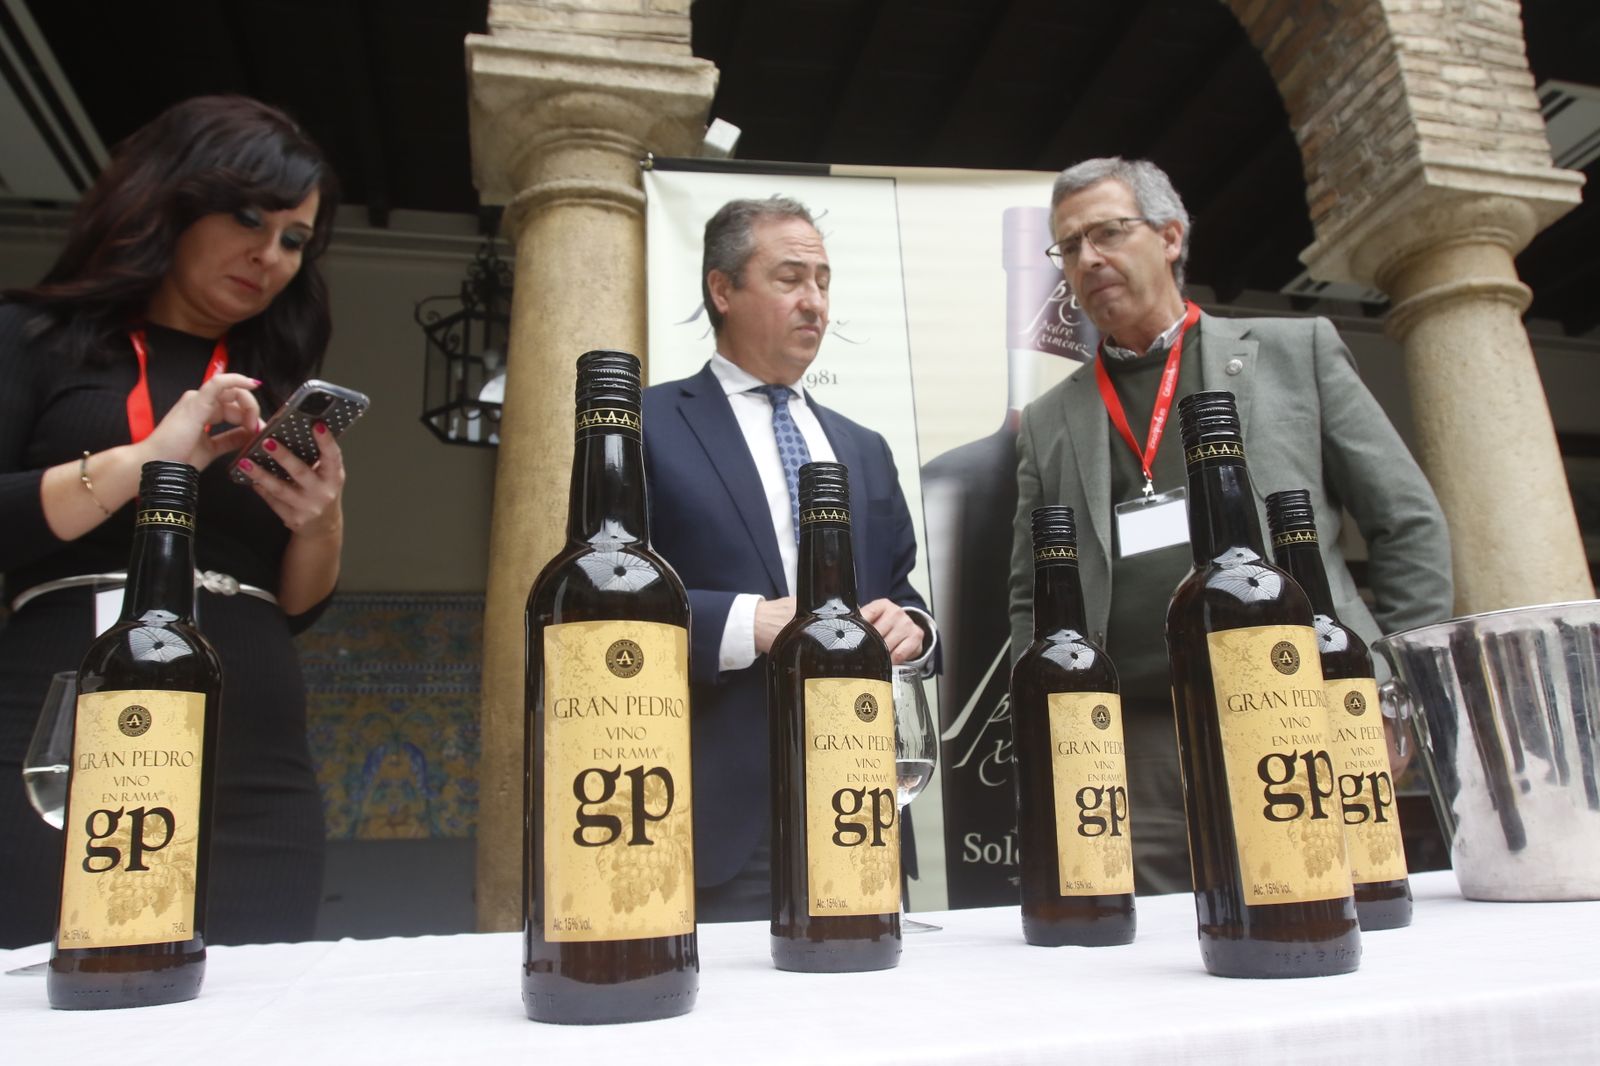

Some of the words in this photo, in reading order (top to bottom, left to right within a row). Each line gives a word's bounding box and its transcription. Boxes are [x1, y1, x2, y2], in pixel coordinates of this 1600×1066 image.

[806, 369, 839, 389] 981
[553, 695, 618, 719] GRAN
[626, 695, 684, 718] PEDRO
[1227, 690, 1288, 713] GRAN
[1280, 715, 1311, 729] VINO
[606, 726, 647, 741] VINO
[1272, 735, 1289, 747] EN
[1291, 734, 1321, 745] RAMA
[1332, 727, 1357, 743] AN
[814, 734, 864, 751] GRAN
[1058, 740, 1101, 755] GRAN
[593, 748, 613, 760] EN
[617, 747, 658, 760] RAMA
[1350, 746, 1375, 756] VINO
[79, 751, 126, 770] GRAN
[132, 750, 194, 768] PEDRO
[855, 758, 881, 769] VINO
[1094, 760, 1115, 769] VINO
[1345, 760, 1358, 769] EN
[113, 775, 150, 787] VINO
[846, 773, 860, 783] EN
[863, 773, 887, 782] RAMA
[1087, 773, 1100, 782] EN
[1257, 749, 1334, 822] gp
[102, 793, 118, 803] EN
[121, 792, 159, 802] RAMA
[1338, 771, 1392, 825] gp
[572, 764, 675, 848] gp
[1075, 785, 1127, 837] gp
[831, 786, 896, 847] gp
[82, 806, 176, 873] gp
